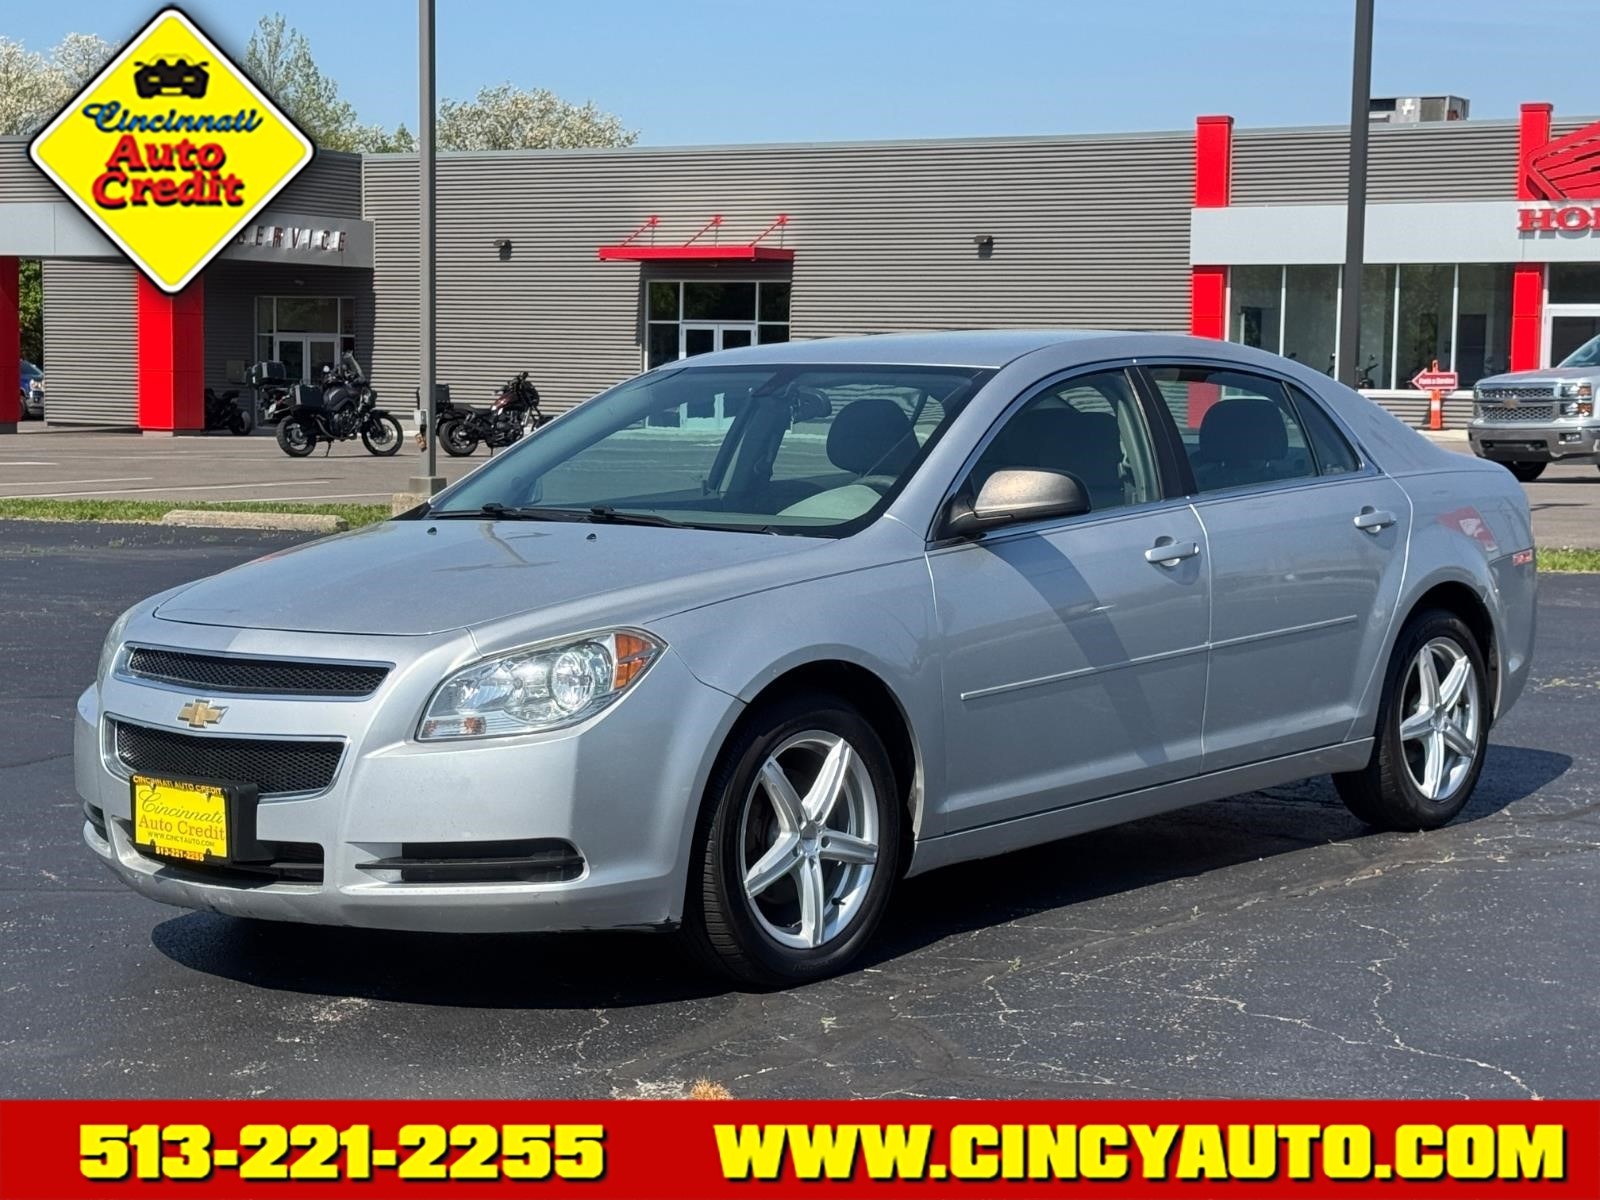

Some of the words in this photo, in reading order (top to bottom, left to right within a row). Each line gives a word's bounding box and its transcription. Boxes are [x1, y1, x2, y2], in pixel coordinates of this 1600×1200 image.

[1517, 207, 1600, 231] HO
[237, 225, 346, 252] SERVICE
[174, 781, 194, 791] AUTO
[195, 784, 222, 795] CREDIT
[138, 789, 223, 824] Cincinnati
[138, 814, 173, 832] Auto
[177, 820, 225, 841] Credit
